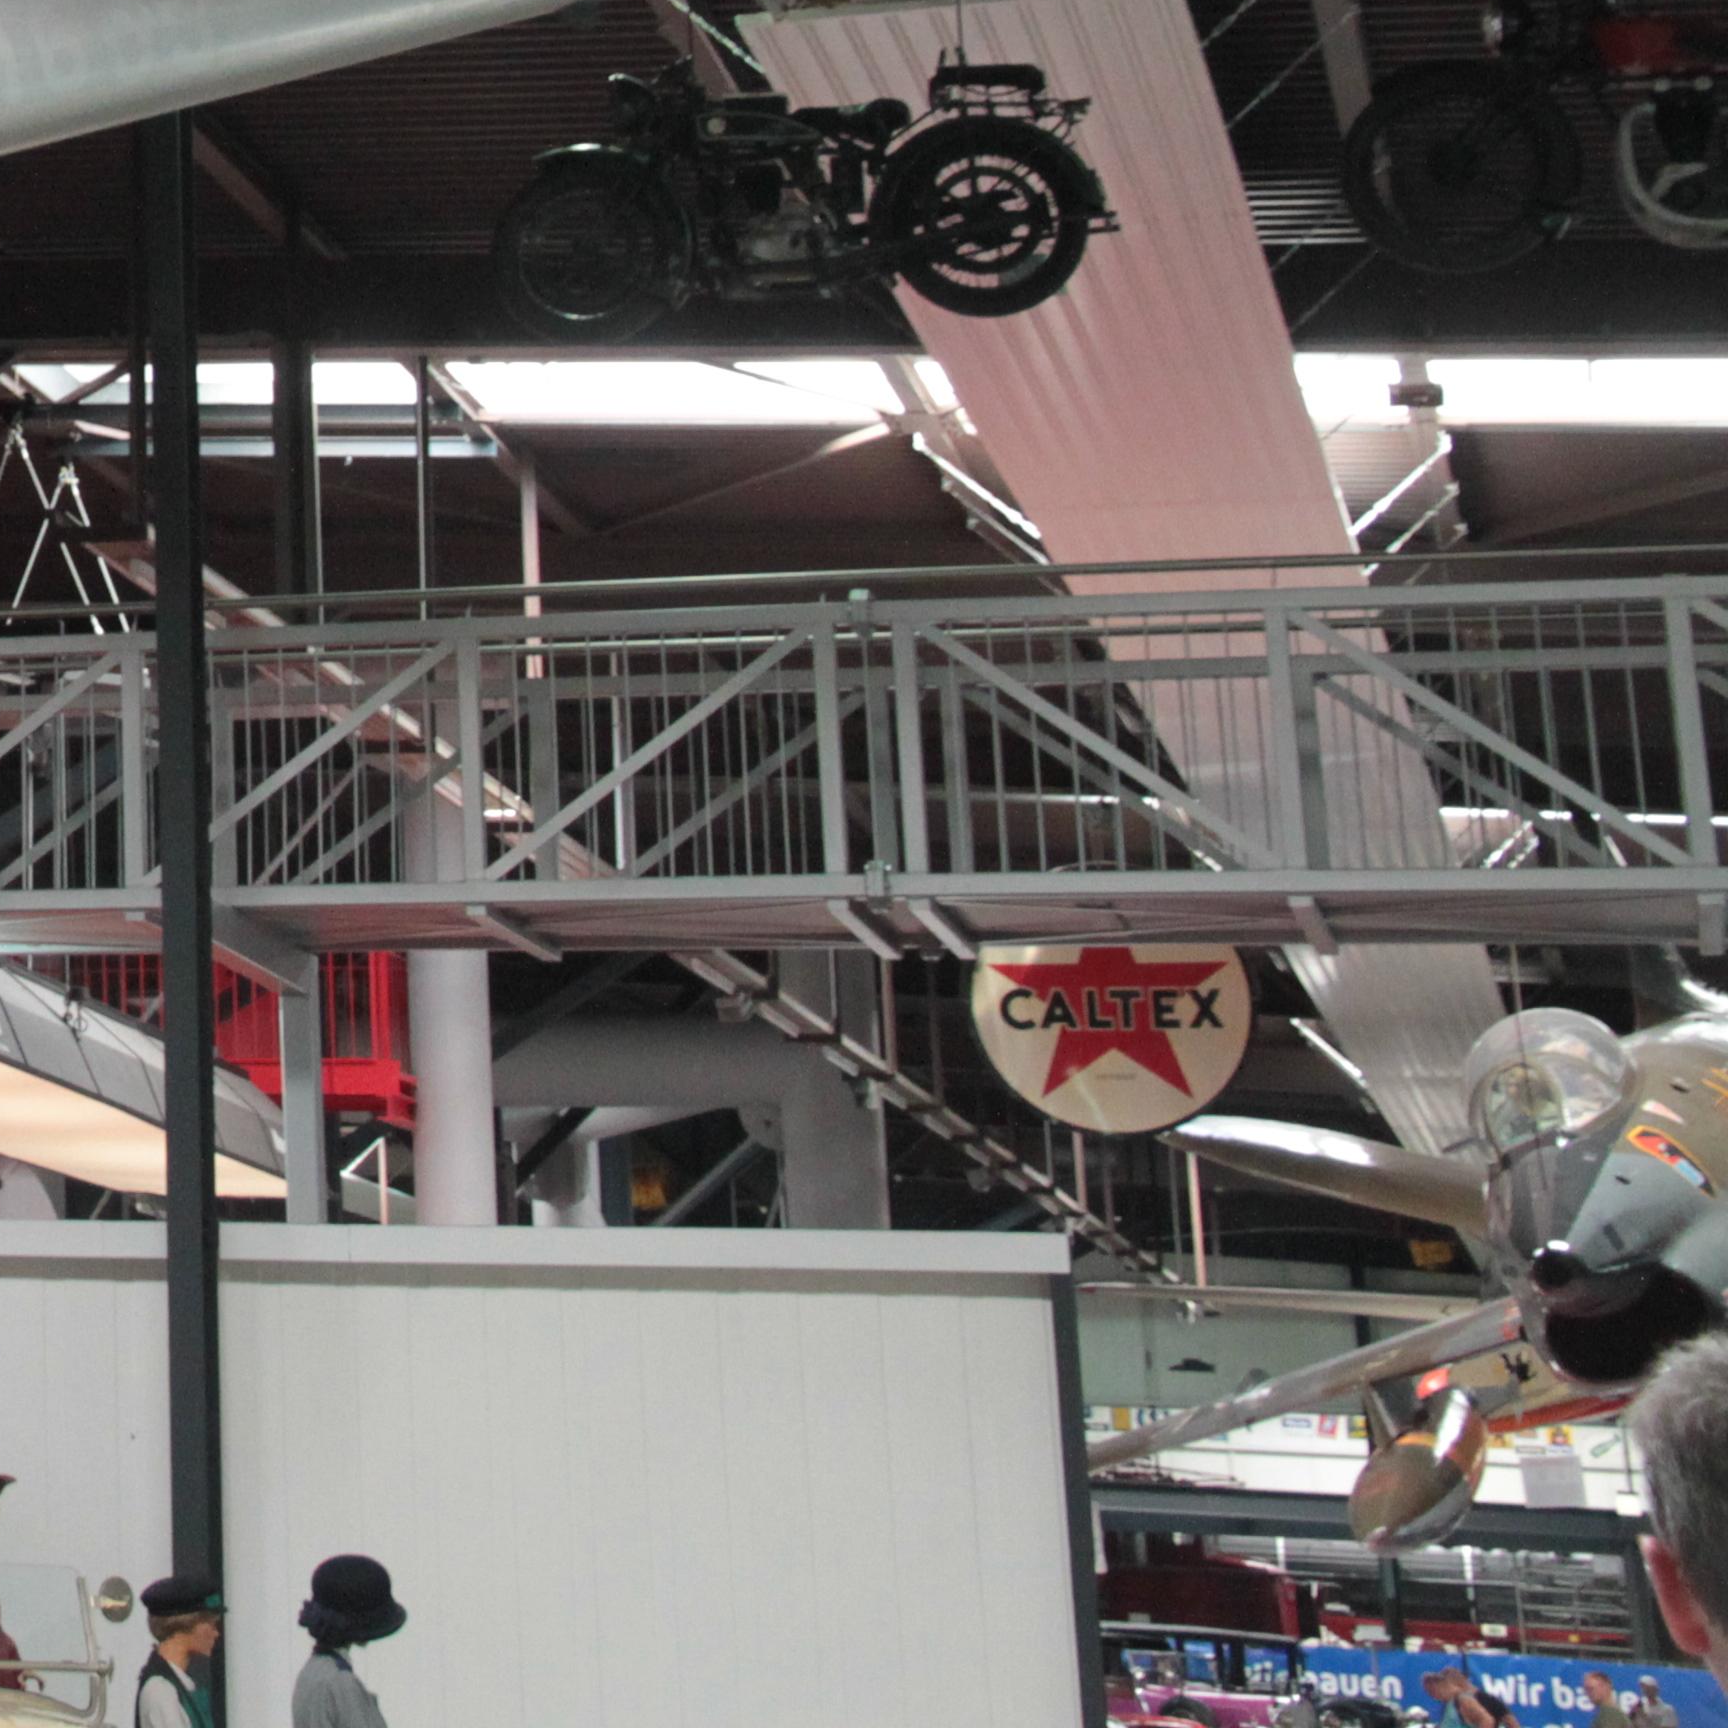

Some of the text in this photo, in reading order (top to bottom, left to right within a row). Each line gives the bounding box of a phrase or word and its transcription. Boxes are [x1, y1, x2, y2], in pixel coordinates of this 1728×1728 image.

[1000, 988, 1224, 1030] CALTEX
[1480, 1673, 1650, 1715] Wir bae
